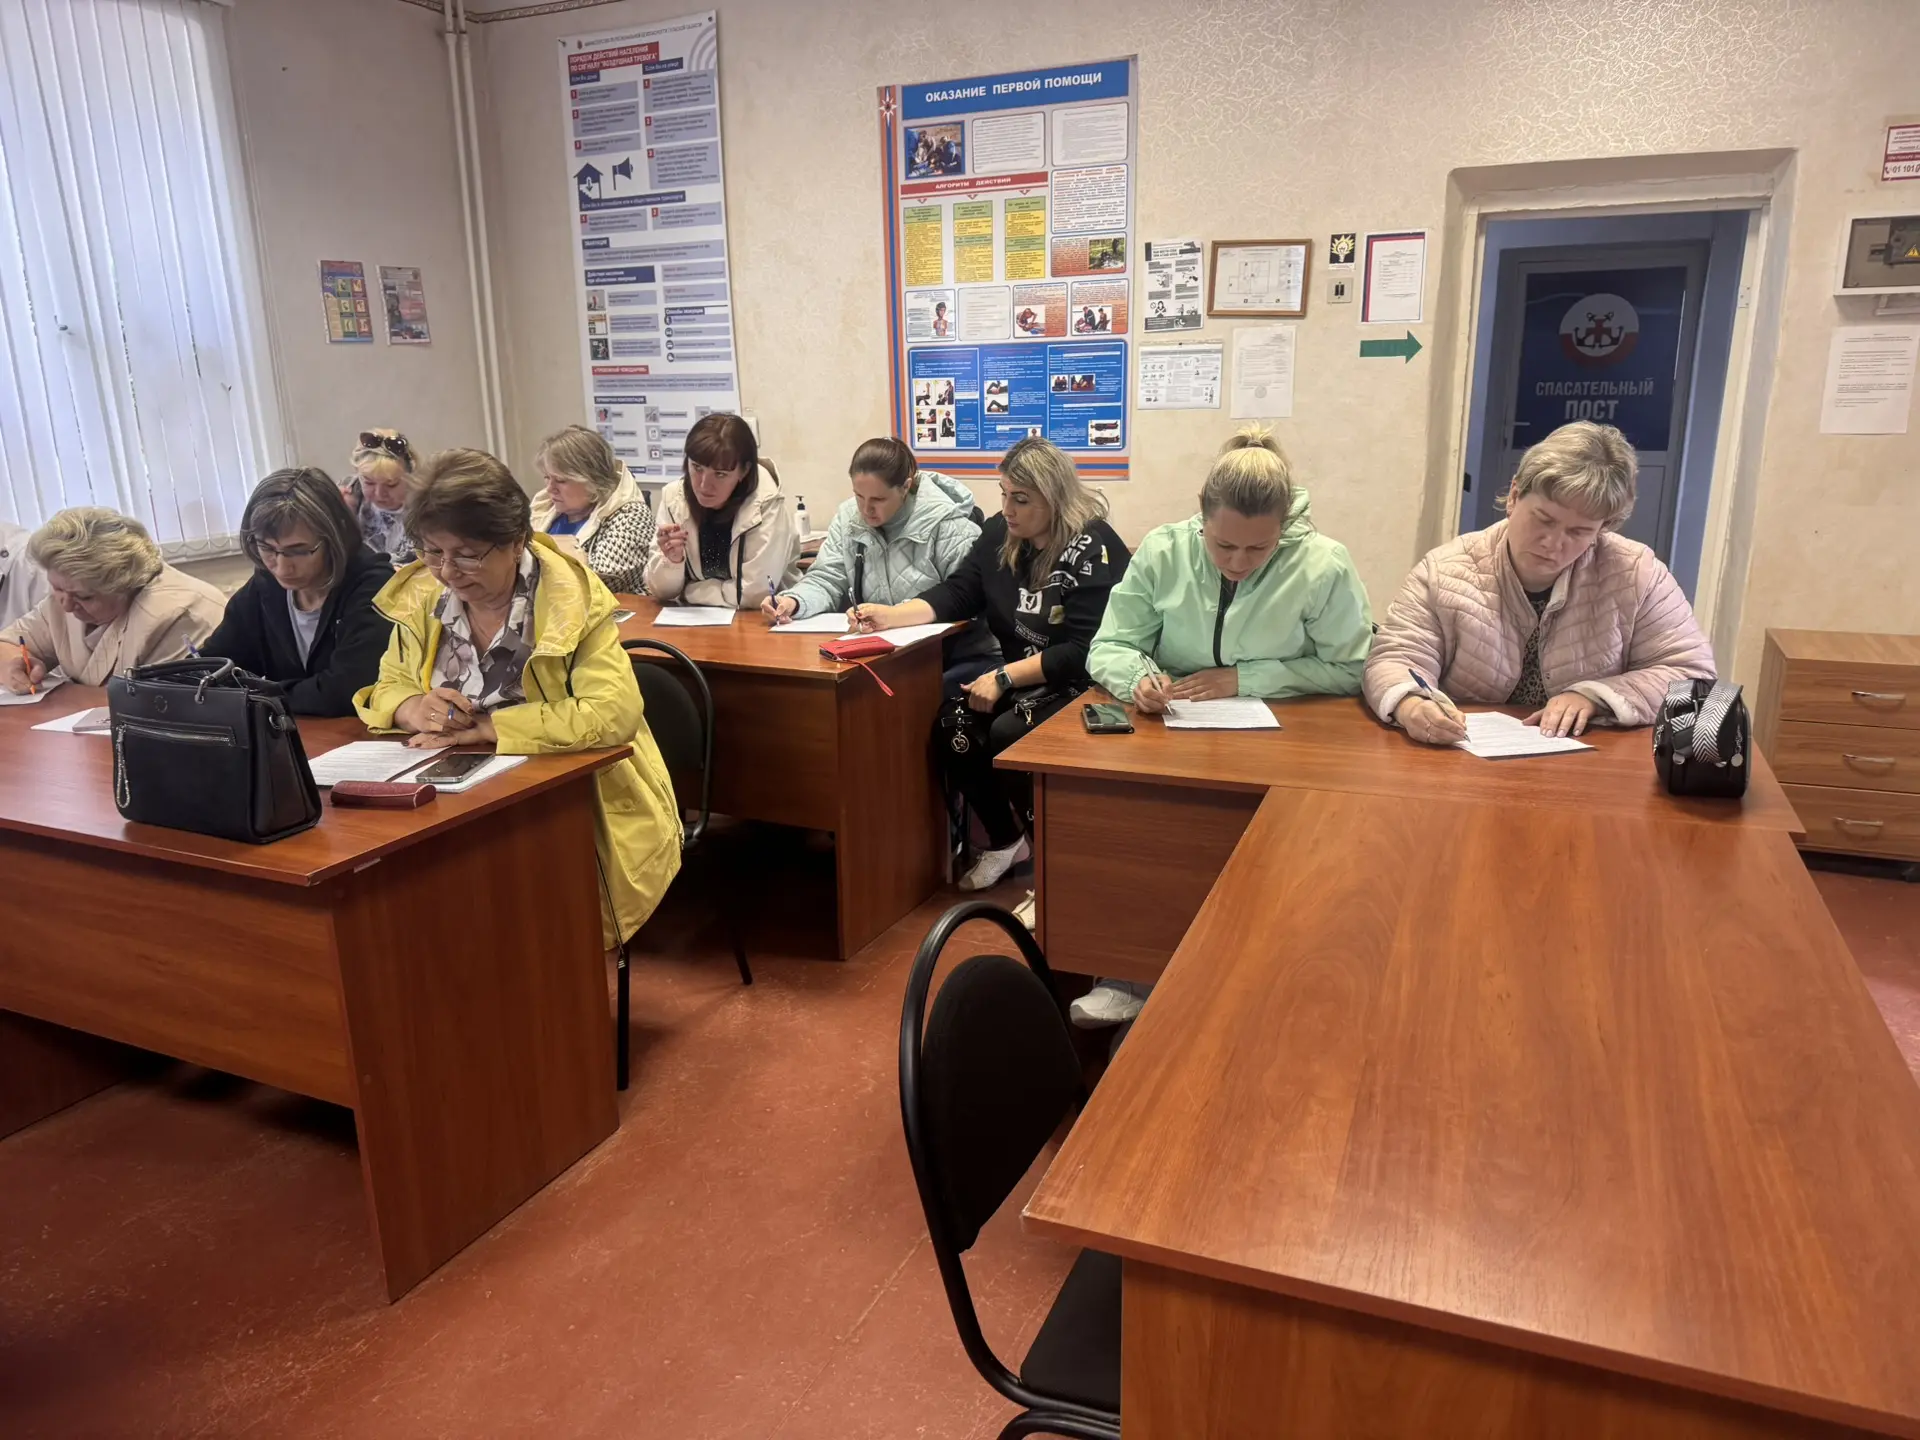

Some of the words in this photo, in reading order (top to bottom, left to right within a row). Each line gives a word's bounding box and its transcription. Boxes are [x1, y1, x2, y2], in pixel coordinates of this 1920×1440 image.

[619, 45, 649, 56] НАСЕЛЕНИЯ
[925, 86, 987, 102] ОКАЗАНИЕ
[992, 78, 1041, 95] ПЕРВОЙ
[1044, 72, 1102, 89] ПОМОЩИ
[935, 181, 969, 190] АЛГОРИТМ
[1535, 378, 1655, 396] СПАСАТЕЛЬНЫЙ
[1564, 400, 1619, 420] ПОСТ
